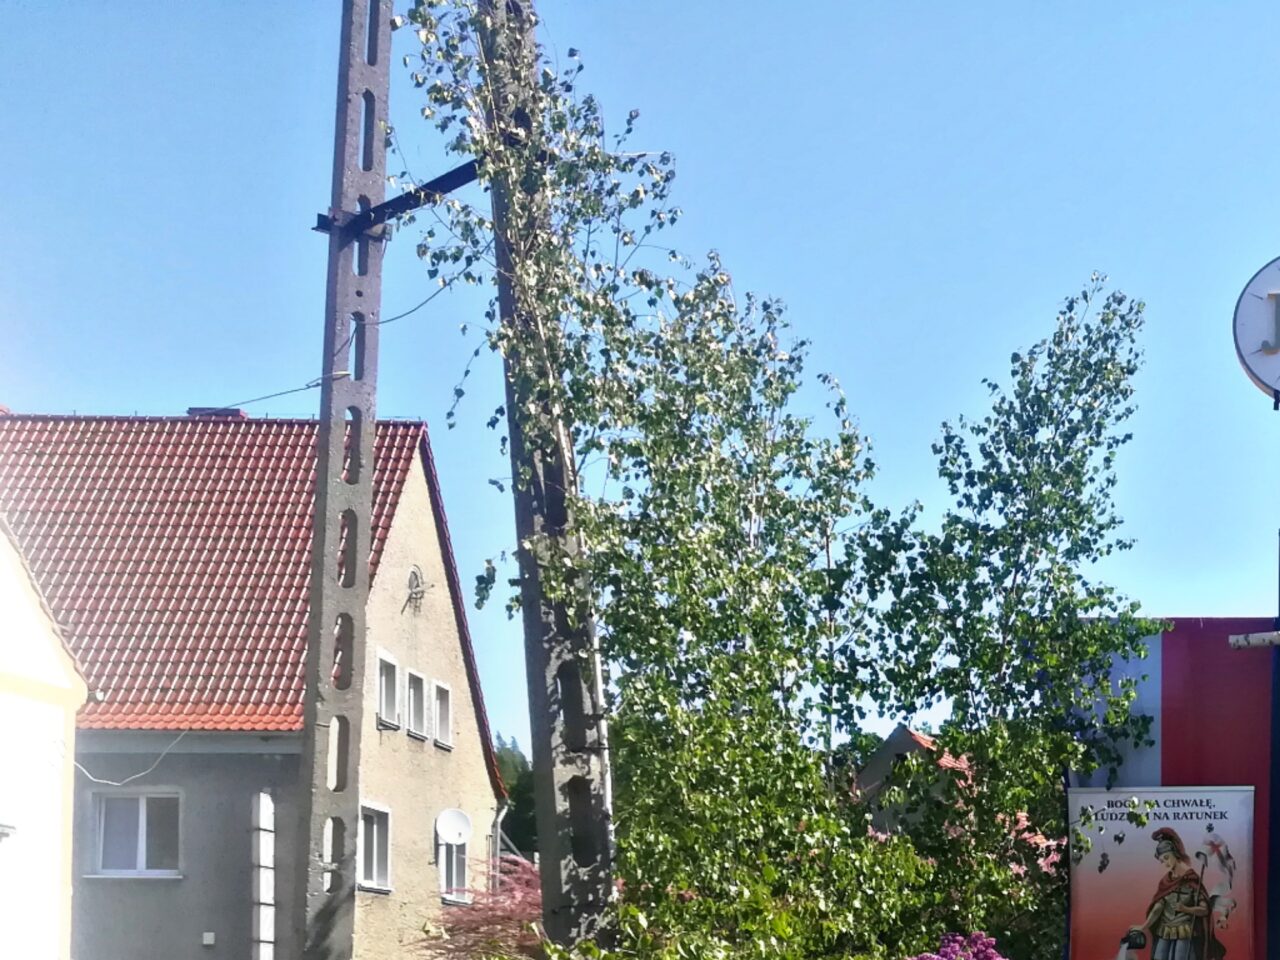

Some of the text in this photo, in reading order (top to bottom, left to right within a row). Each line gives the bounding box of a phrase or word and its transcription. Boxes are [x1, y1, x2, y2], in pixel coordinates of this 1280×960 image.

[1107, 800, 1138, 809] BOG
[1094, 811, 1228, 822] LUDZ NA RATUNEK
